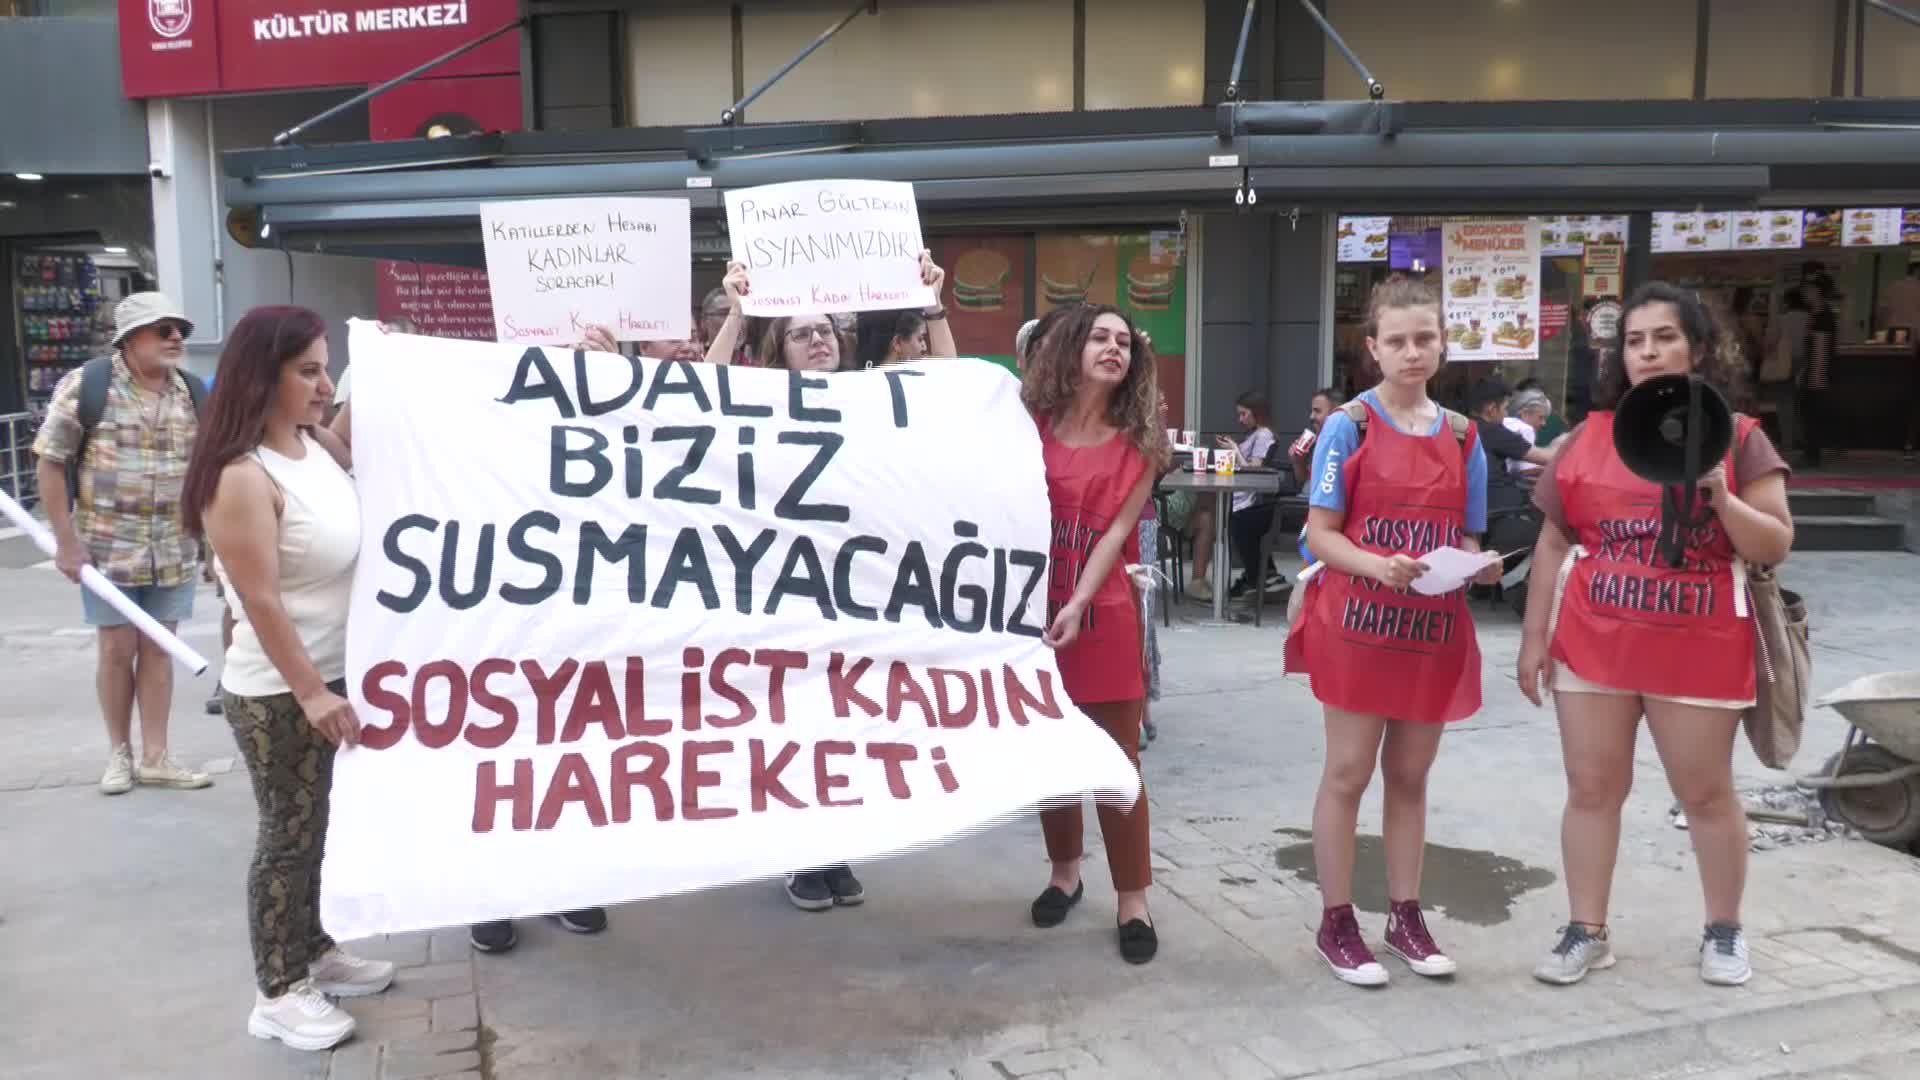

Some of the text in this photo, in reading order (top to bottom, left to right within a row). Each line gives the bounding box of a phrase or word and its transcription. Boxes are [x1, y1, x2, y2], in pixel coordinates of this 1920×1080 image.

[253, 0, 467, 40] KÜLTÜR MERKEZİ
[606, 211, 657, 233] HESABI
[741, 199, 808, 224] PINAR
[527, 243, 635, 272] KADINLAR
[492, 346, 926, 428] ADALET
[376, 510, 1047, 638] SUSMAYACAĞIZ
[1589, 570, 1715, 617] HAREKETİ
[359, 646, 1065, 751] SOSYALİST KADIN
[472, 738, 960, 832] HAREKETİ
